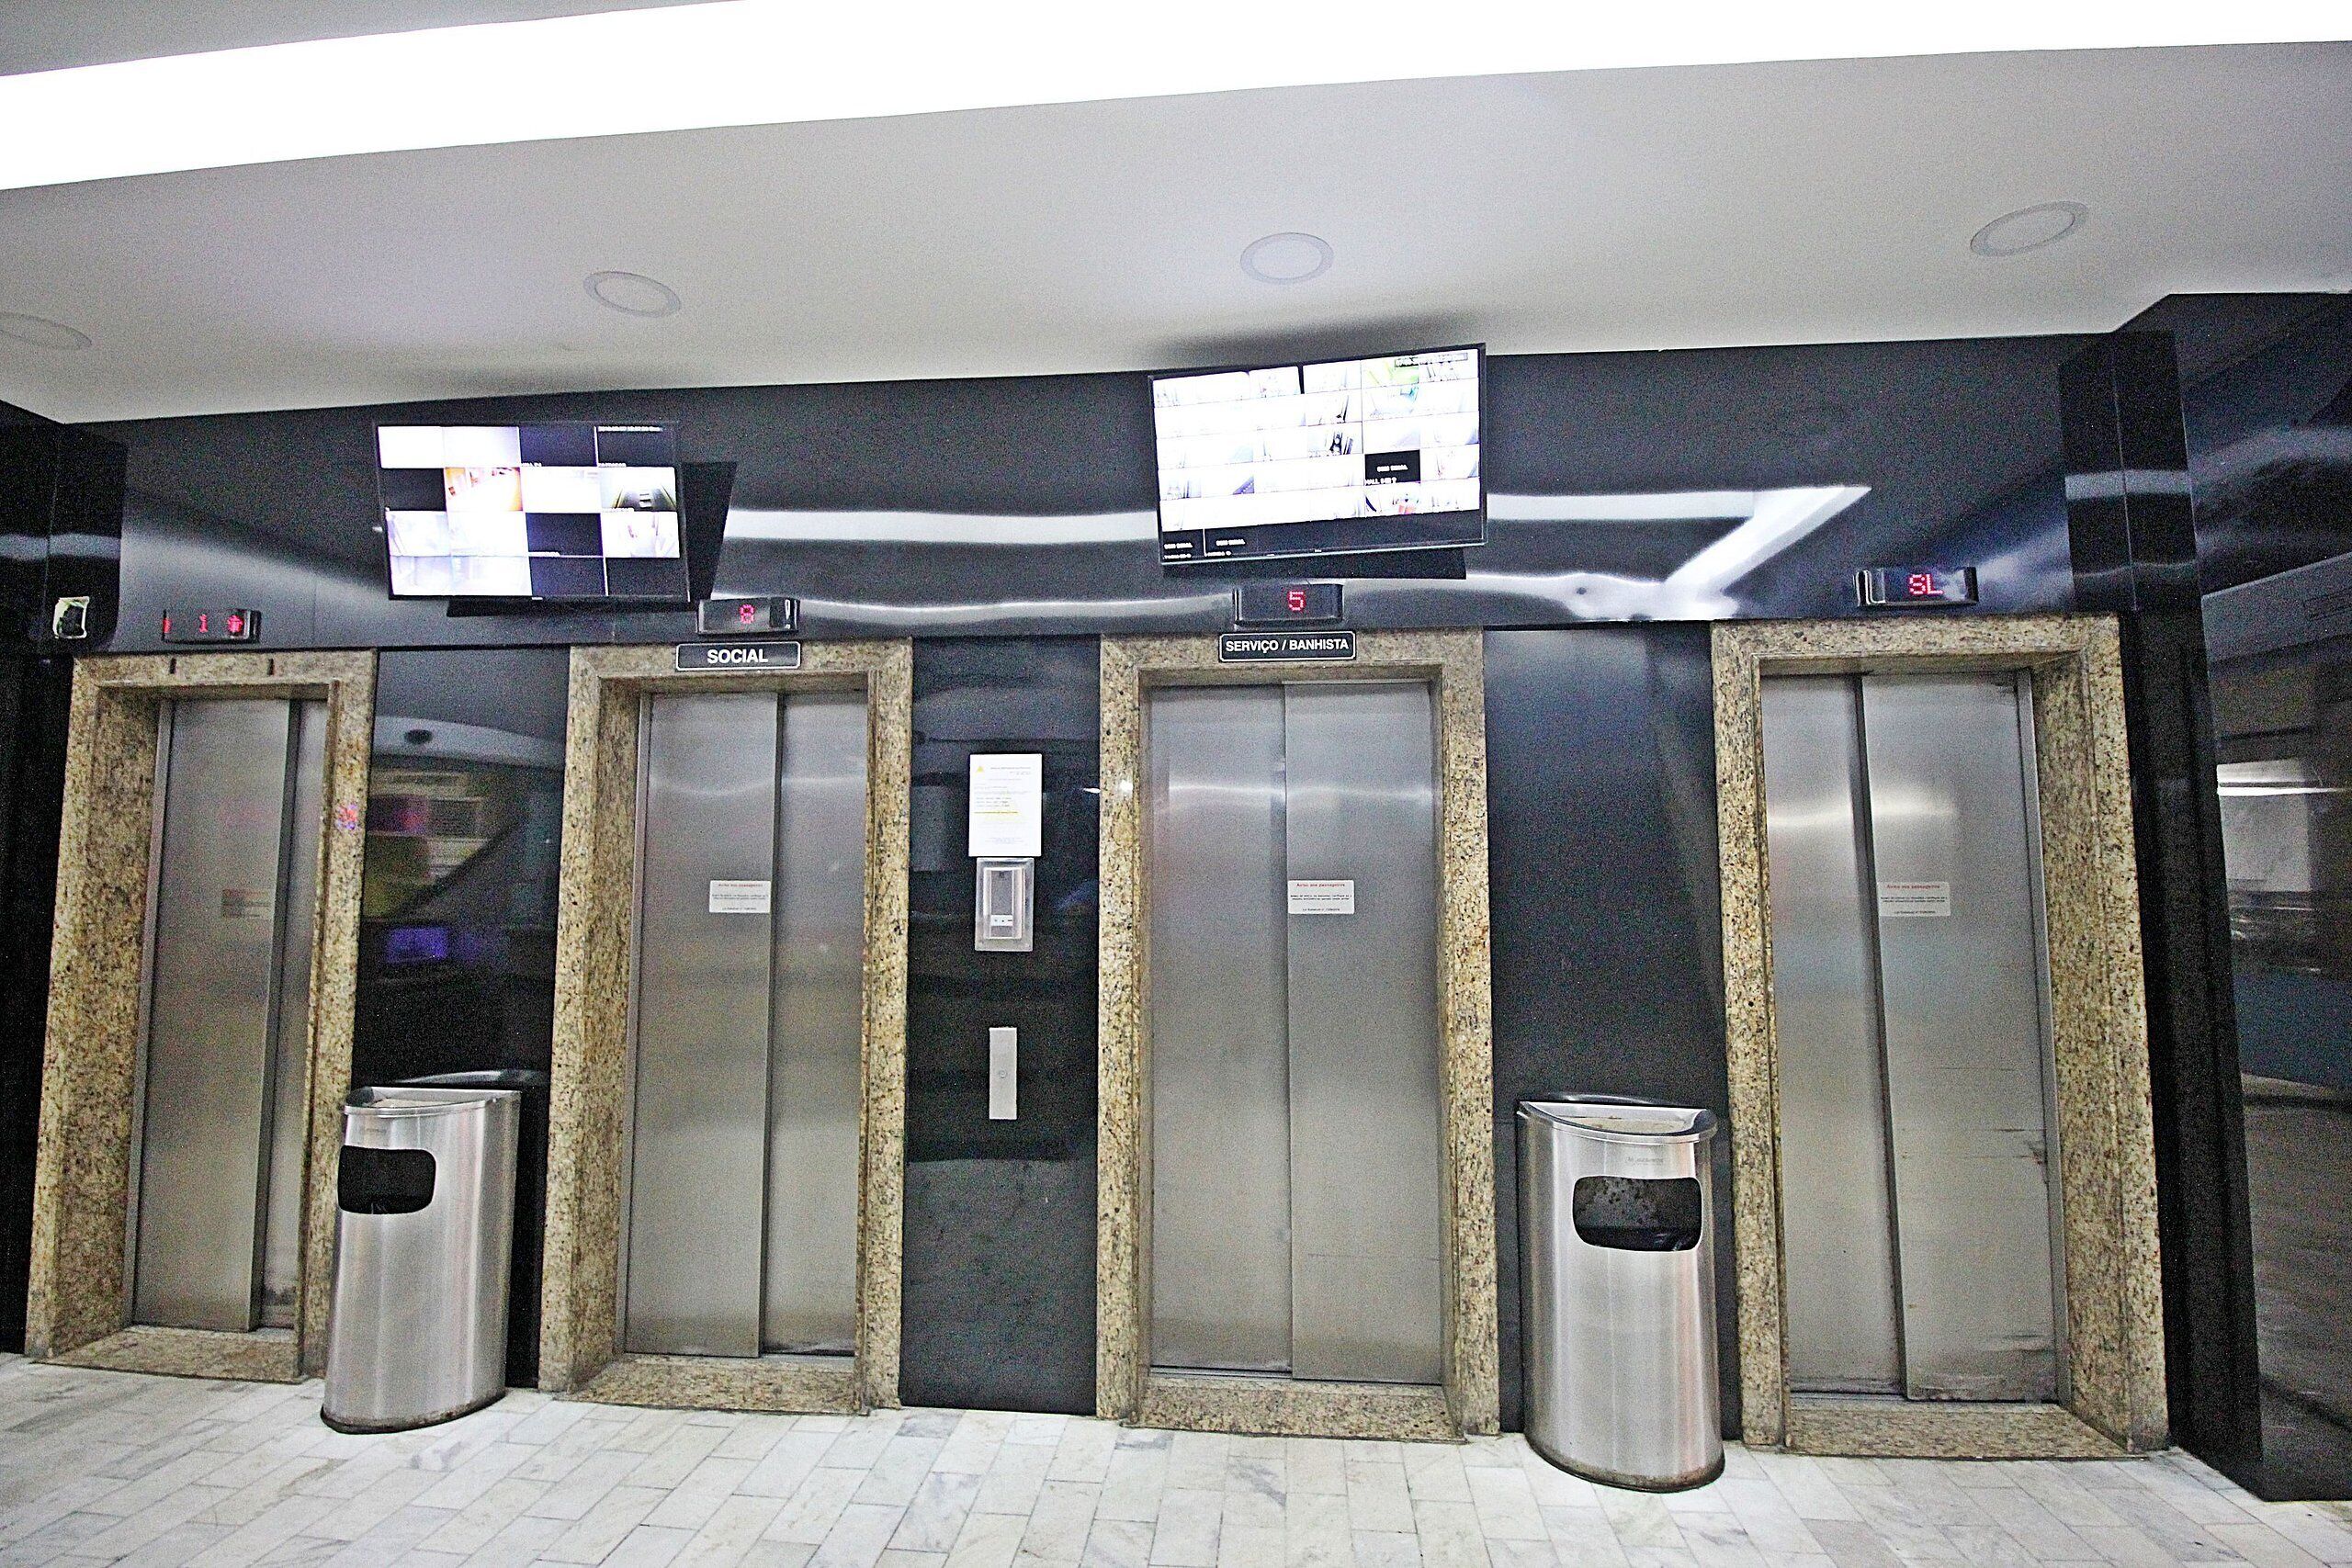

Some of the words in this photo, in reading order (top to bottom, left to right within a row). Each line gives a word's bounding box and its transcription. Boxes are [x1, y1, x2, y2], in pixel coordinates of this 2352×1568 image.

[1288, 590, 1306, 612] 5
[1226, 640, 1279, 653] SERVIÇO
[1289, 638, 1349, 650] BANHISTA
[707, 649, 769, 664] SOCIAL
